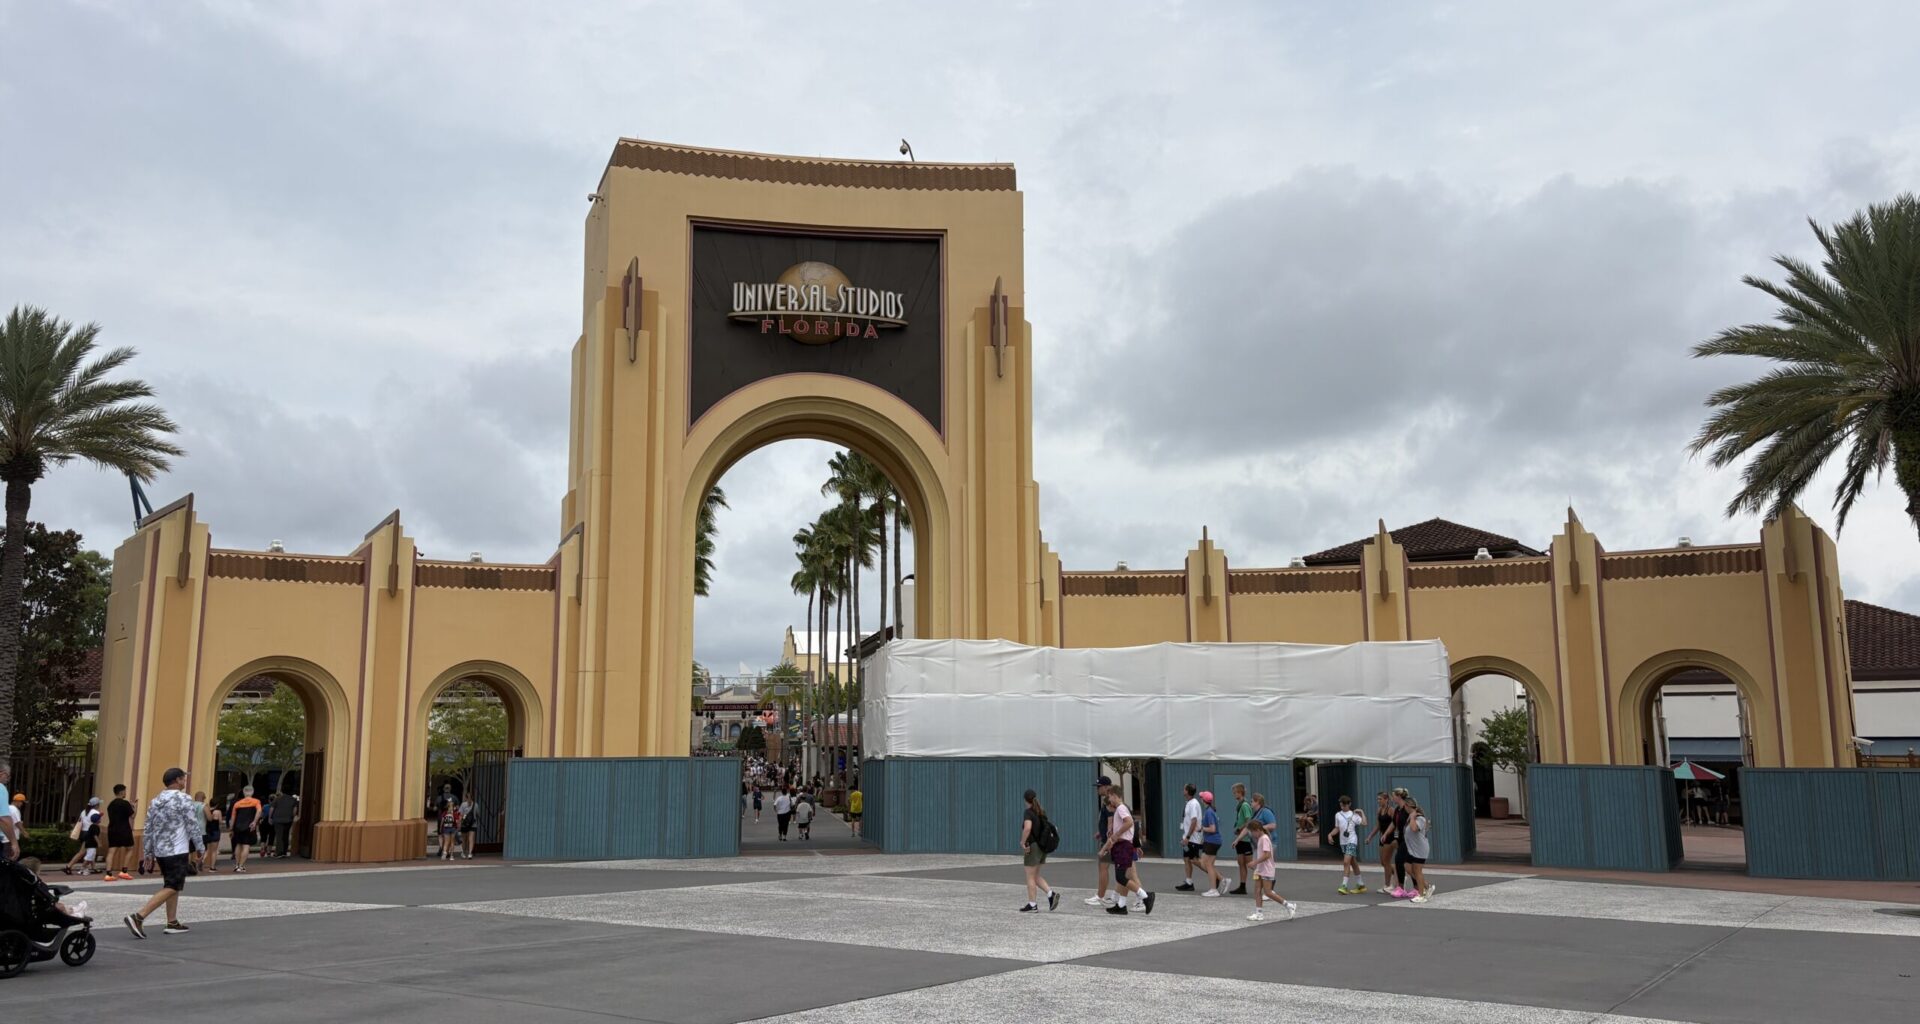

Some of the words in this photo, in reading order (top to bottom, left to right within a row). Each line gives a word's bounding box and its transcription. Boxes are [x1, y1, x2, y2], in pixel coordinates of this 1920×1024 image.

[732, 282, 832, 312] UNIVERSAL
[838, 283, 904, 319] STUDIOS
[761, 320, 879, 338] FLORIDA
